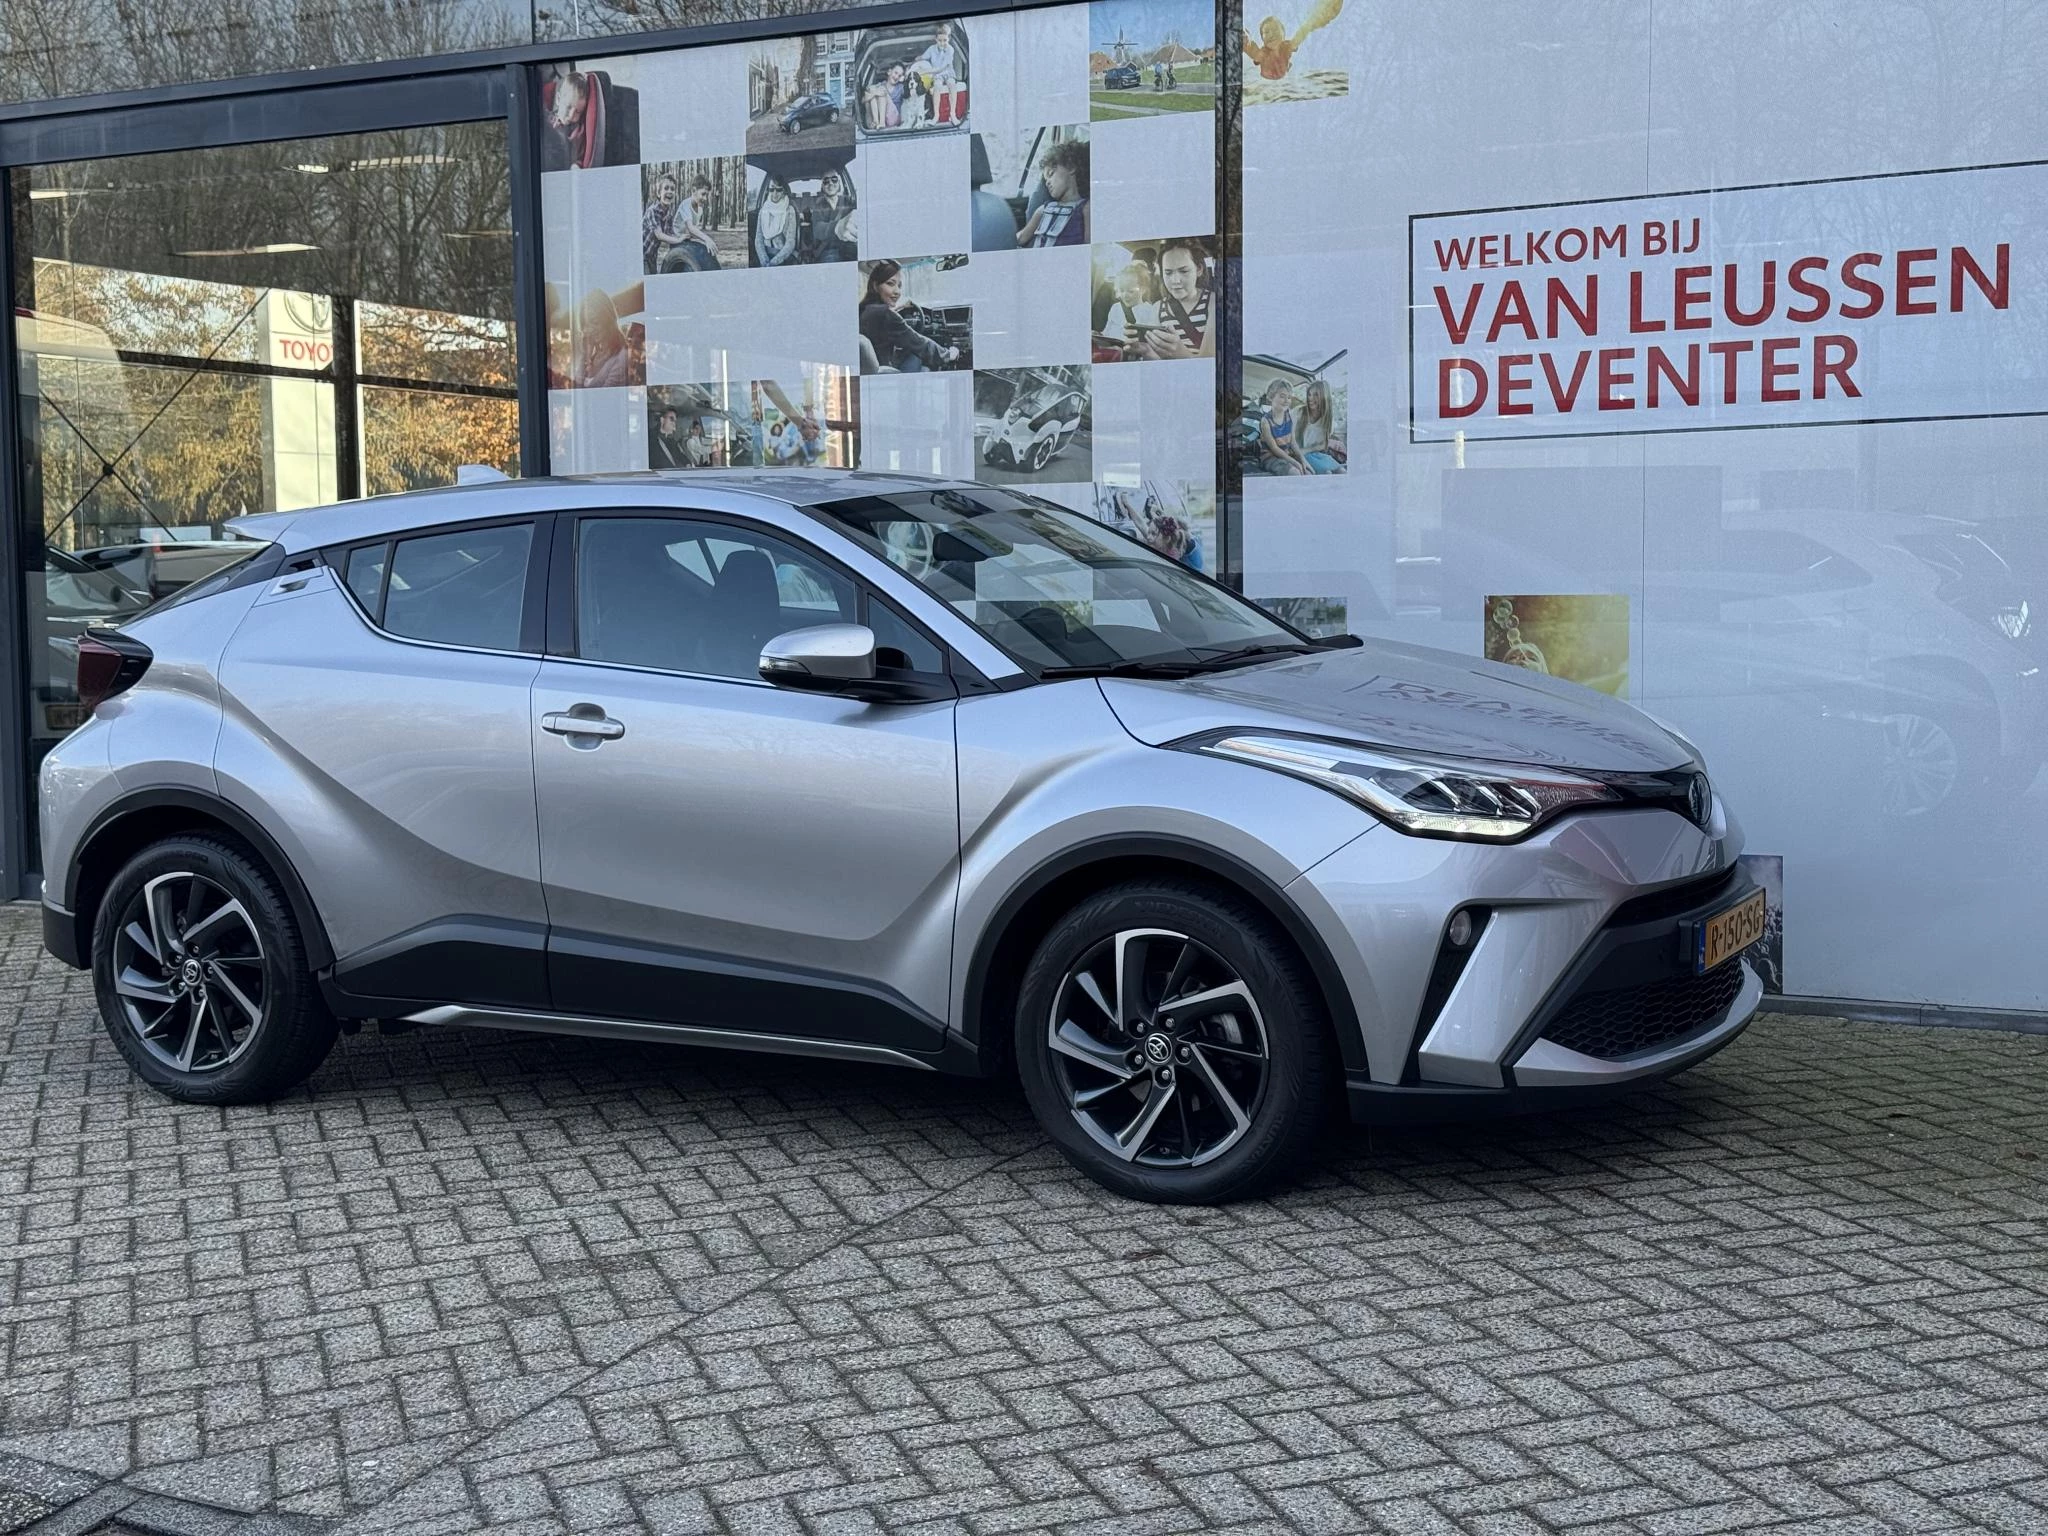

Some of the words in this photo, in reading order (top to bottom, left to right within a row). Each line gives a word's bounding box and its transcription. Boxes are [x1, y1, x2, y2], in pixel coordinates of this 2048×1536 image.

[1434, 224, 1627, 272] WELKOM
[1642, 218, 1700, 256] BIJ
[1433, 274, 1598, 345] VAN
[1629, 243, 2010, 333] LEUSSEN
[279, 339, 333, 362] TOYO
[1438, 335, 1862, 419] DEVENTER
[1710, 900, 1760, 960] R-150-SG
